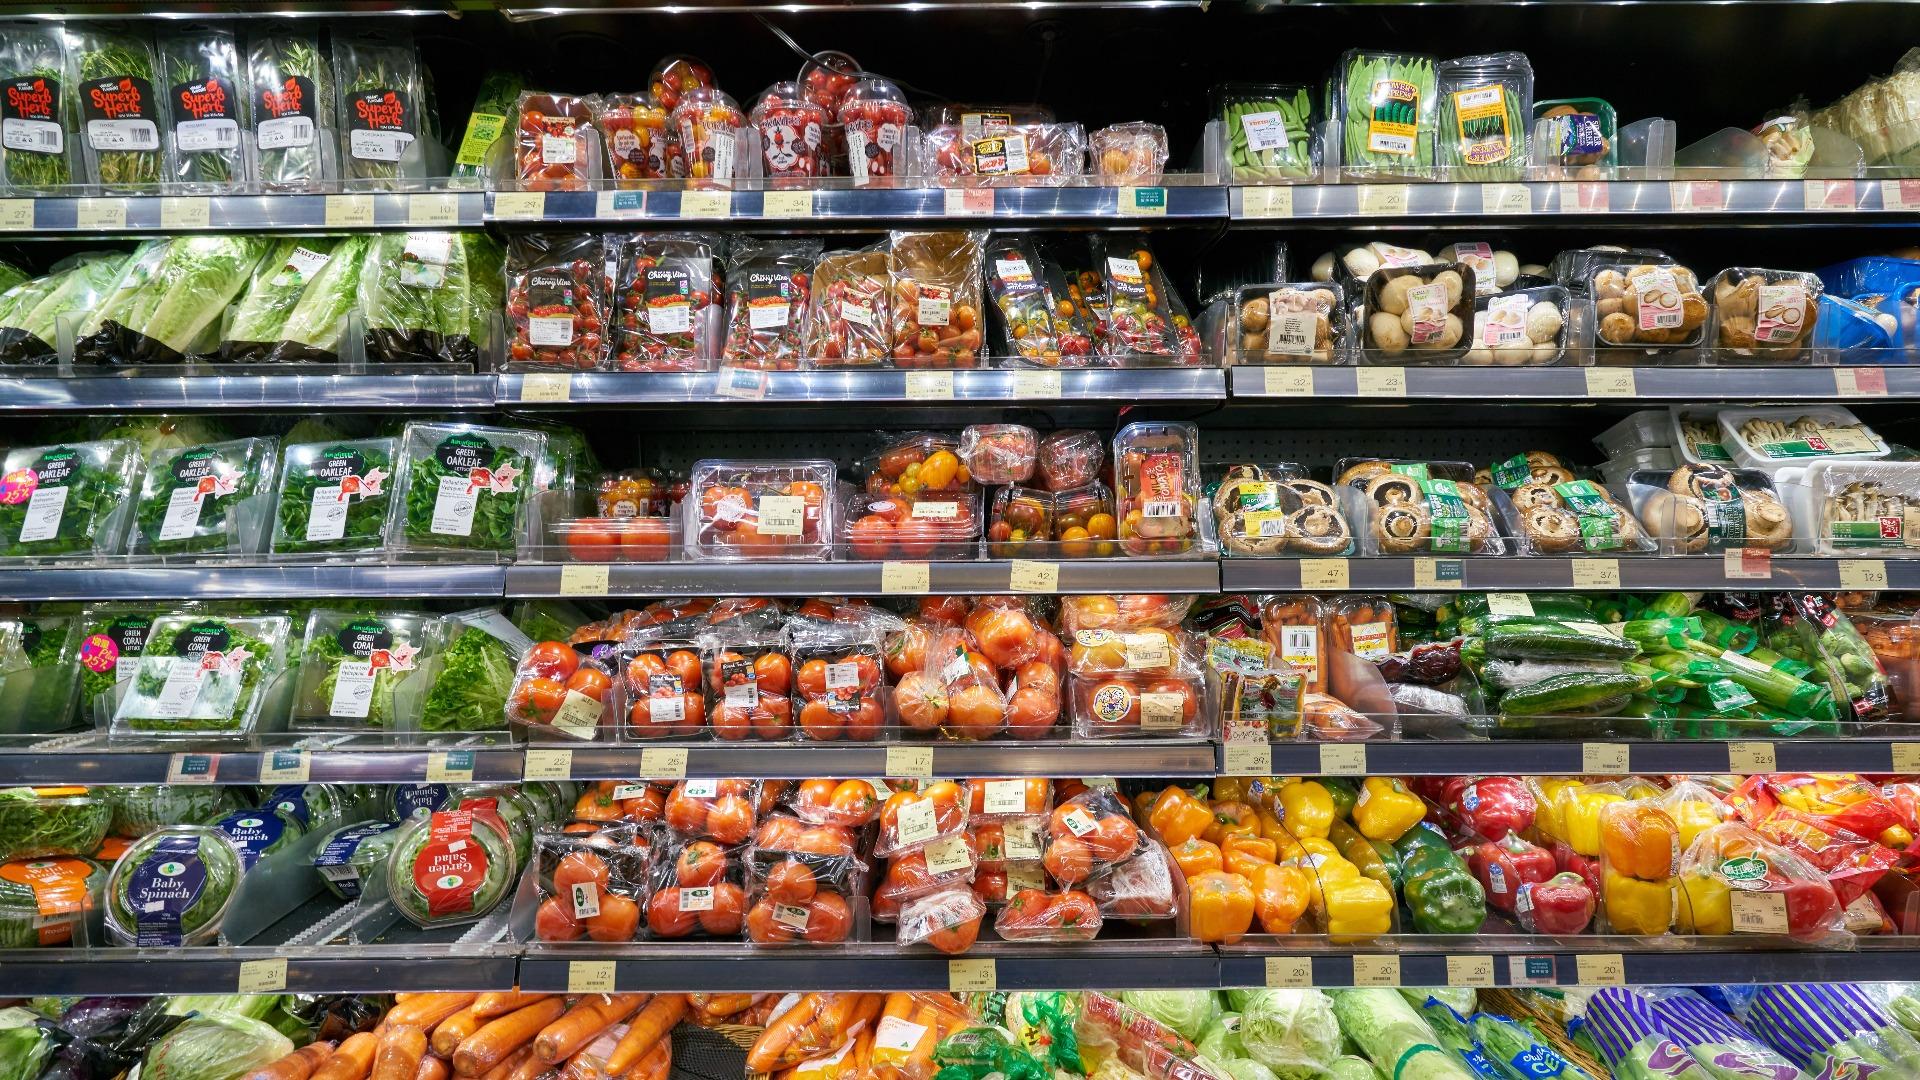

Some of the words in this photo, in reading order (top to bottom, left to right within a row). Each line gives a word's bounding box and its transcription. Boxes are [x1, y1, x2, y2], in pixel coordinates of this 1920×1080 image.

[8, 88, 52, 108] Superb
[91, 88, 142, 109] Superb
[181, 88, 226, 110] Superb
[263, 86, 304, 110] Superb
[19, 102, 52, 119] Herb
[104, 102, 142, 119] Herb
[192, 103, 225, 119] Herb
[272, 100, 302, 118] Herb
[356, 100, 406, 119] Superb
[368, 113, 405, 129] Herb
[1583, 121, 1594, 146] CREEK
[647, 271, 673, 282] Cherry
[749, 273, 774, 285] Cherry
[531, 277, 556, 290] Cherry
[556, 278, 572, 286] Vine
[455, 448, 476, 456] GREEN
[48, 461, 65, 470] GREEN
[188, 459, 206, 468] GREEN
[329, 460, 347, 468] GREEN
[446, 456, 483, 468] OAKLEAF
[39, 468, 71, 480] OAKLEAF
[179, 467, 210, 478] OAKLEAF
[320, 466, 353, 478] OAKLEAF
[1150, 474, 1161, 496] WILD
[1155, 464, 1172, 503] TOMATO
[1327, 569, 1338, 577] 47
[1864, 573, 1883, 582] 12.9
[122, 637, 143, 646] CORAL
[193, 635, 212, 643] GREEN
[188, 643, 209, 651] CORAL
[353, 641, 374, 650] CORAL
[553, 758, 566, 766] 22
[915, 757, 925, 765] 17
[1253, 756, 1265, 765] 39
[1755, 756, 1773, 764] 22.9
[405, 785, 438, 799] Spinach
[411, 796, 433, 806] Baby
[230, 827, 262, 836] Baby
[434, 852, 467, 865] Salad
[427, 861, 473, 874] Garden
[151, 877, 185, 891] Baby
[140, 887, 190, 902] Spinach
[1293, 969, 1304, 977] 20
[1380, 966, 1392, 975] 20
[1474, 966, 1486, 975] 20
[1604, 966, 1616, 974] 20
